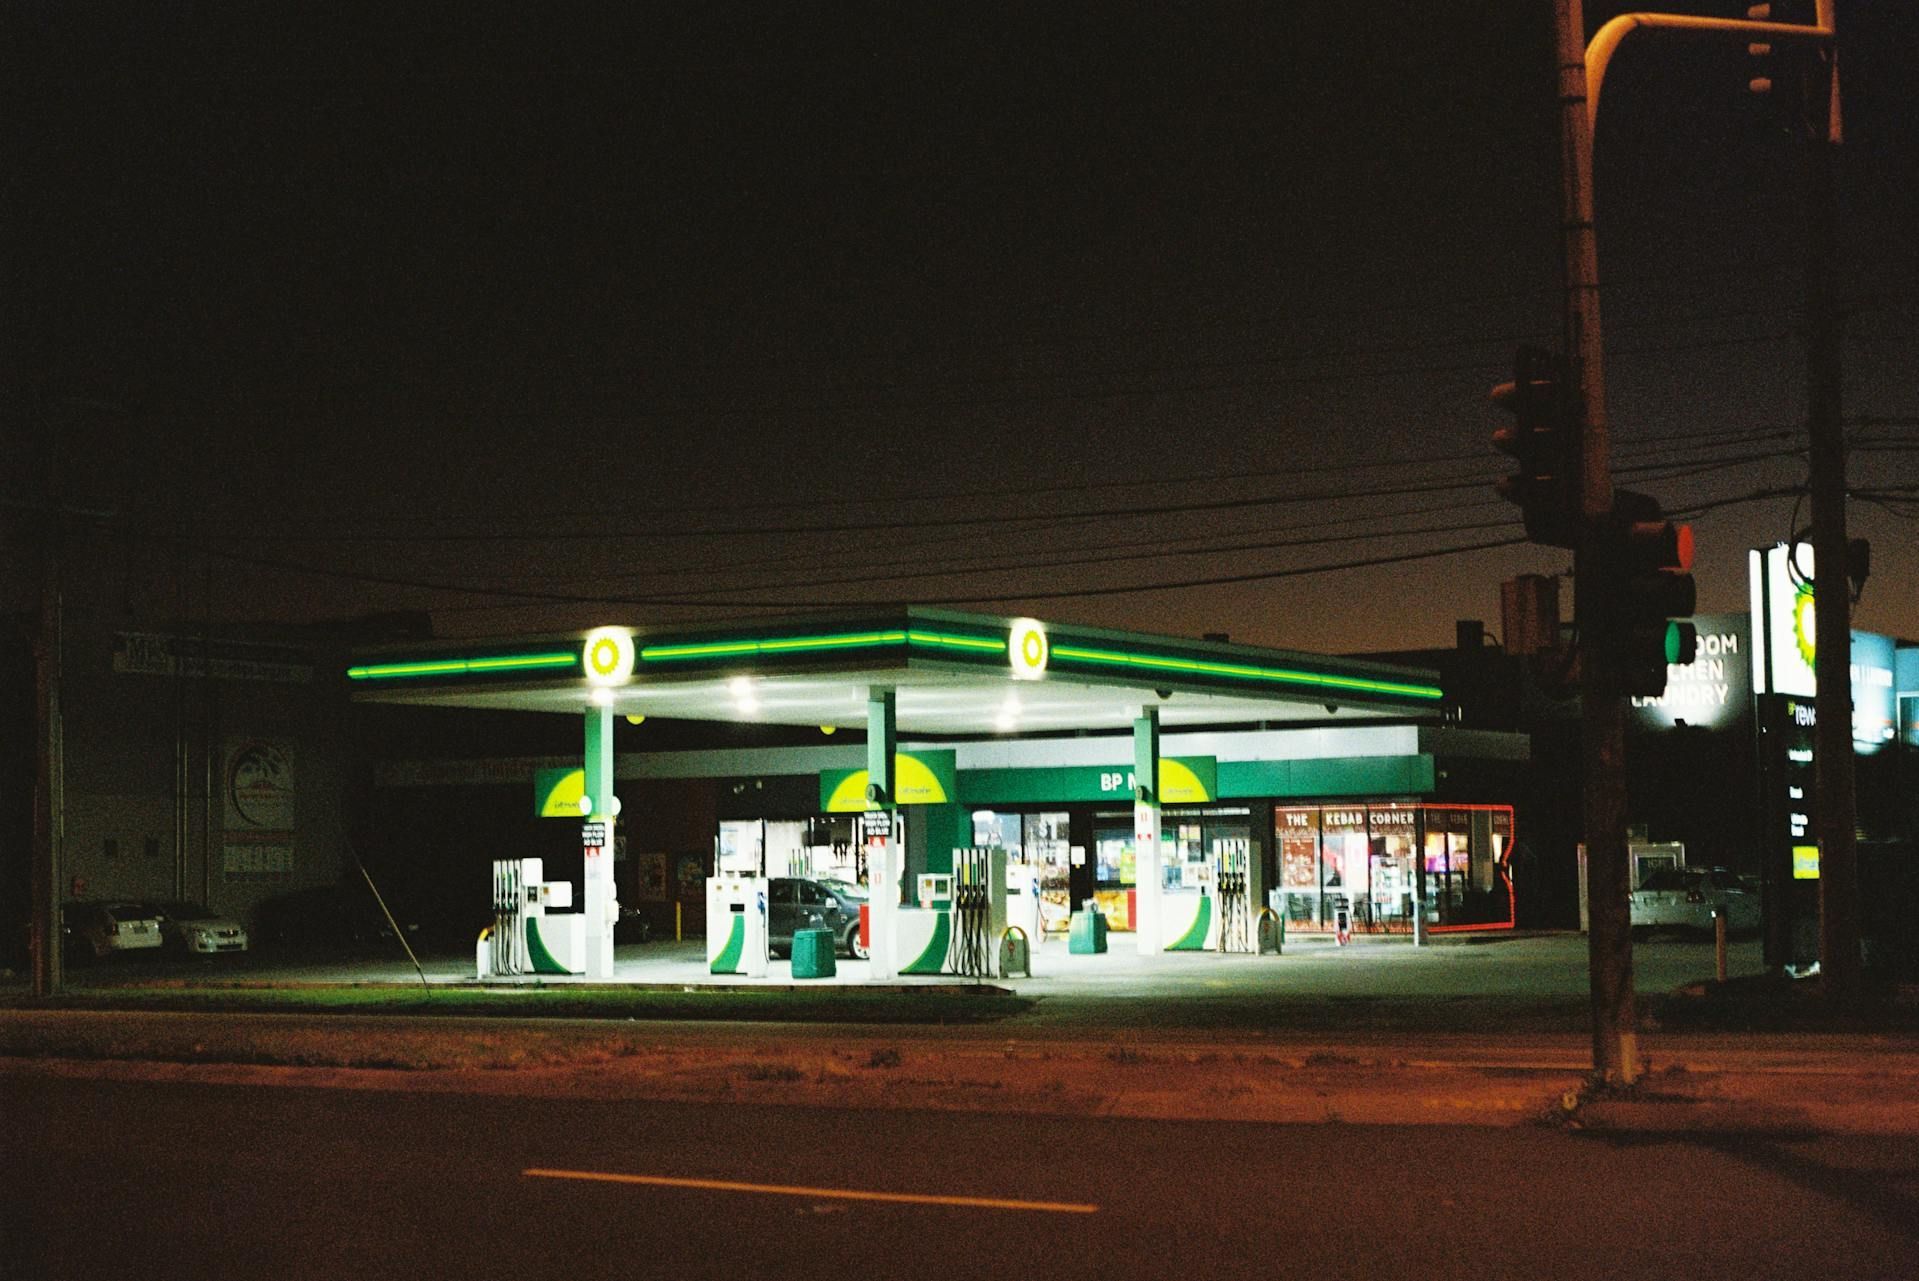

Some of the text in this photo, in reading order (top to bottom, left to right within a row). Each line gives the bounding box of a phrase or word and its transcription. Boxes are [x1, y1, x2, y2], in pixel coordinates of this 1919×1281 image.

[1101, 772, 1123, 792] BP
[1286, 812, 1415, 827] THE KEBAB CORNER
